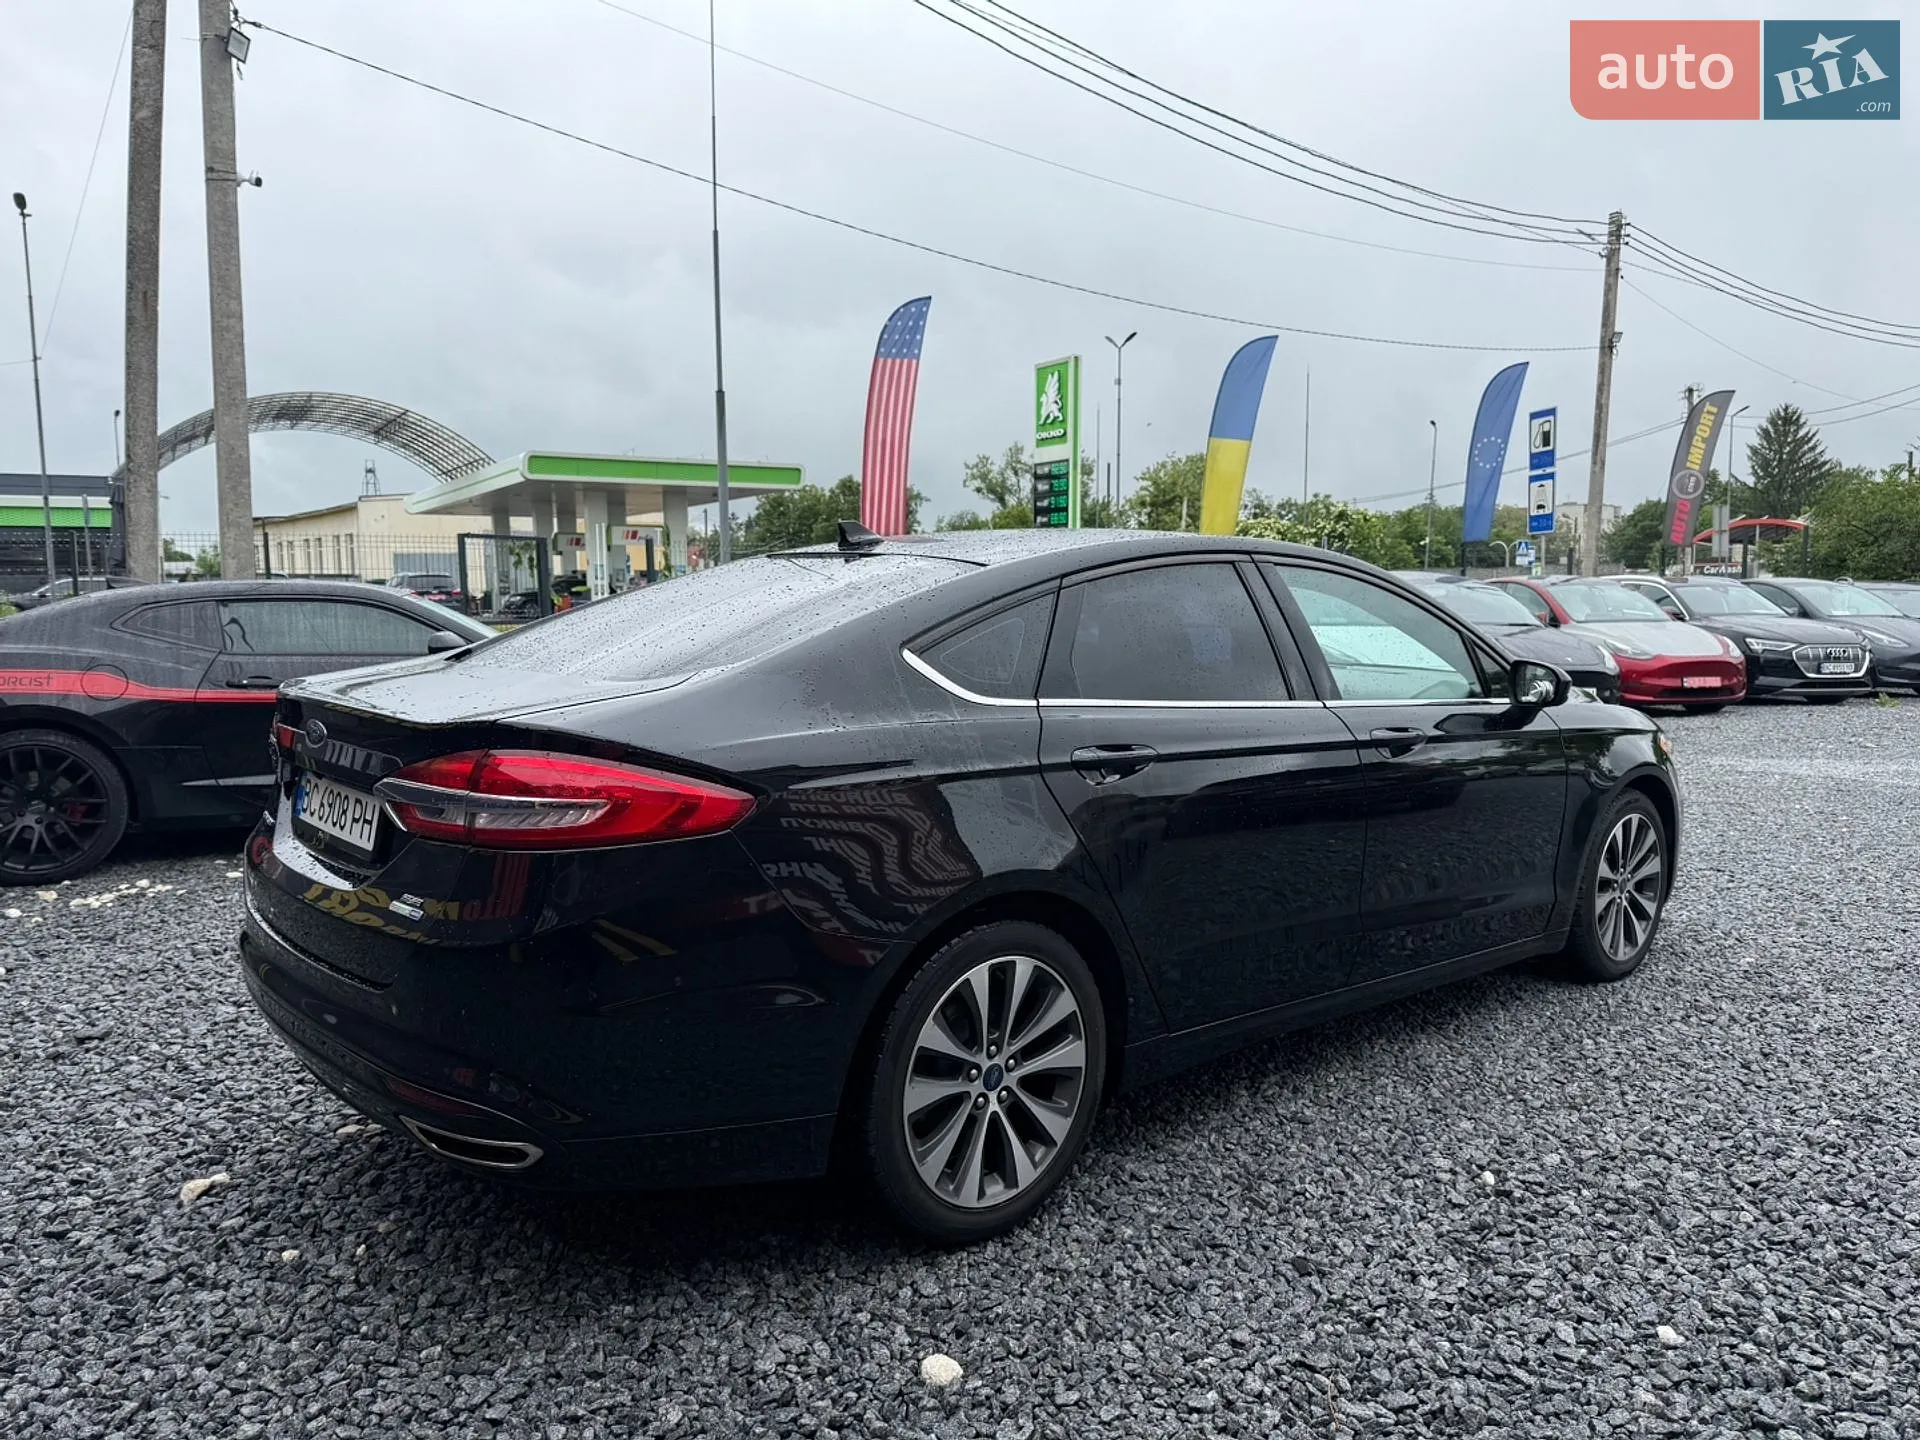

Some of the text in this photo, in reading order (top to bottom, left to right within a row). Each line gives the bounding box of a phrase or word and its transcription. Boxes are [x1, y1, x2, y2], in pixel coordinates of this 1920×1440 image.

[1686, 402, 1719, 471] IMPORT
[1669, 498, 1692, 544] AUTO
[317, 785, 350, 832] 6908
[349, 797, 376, 843] PH
